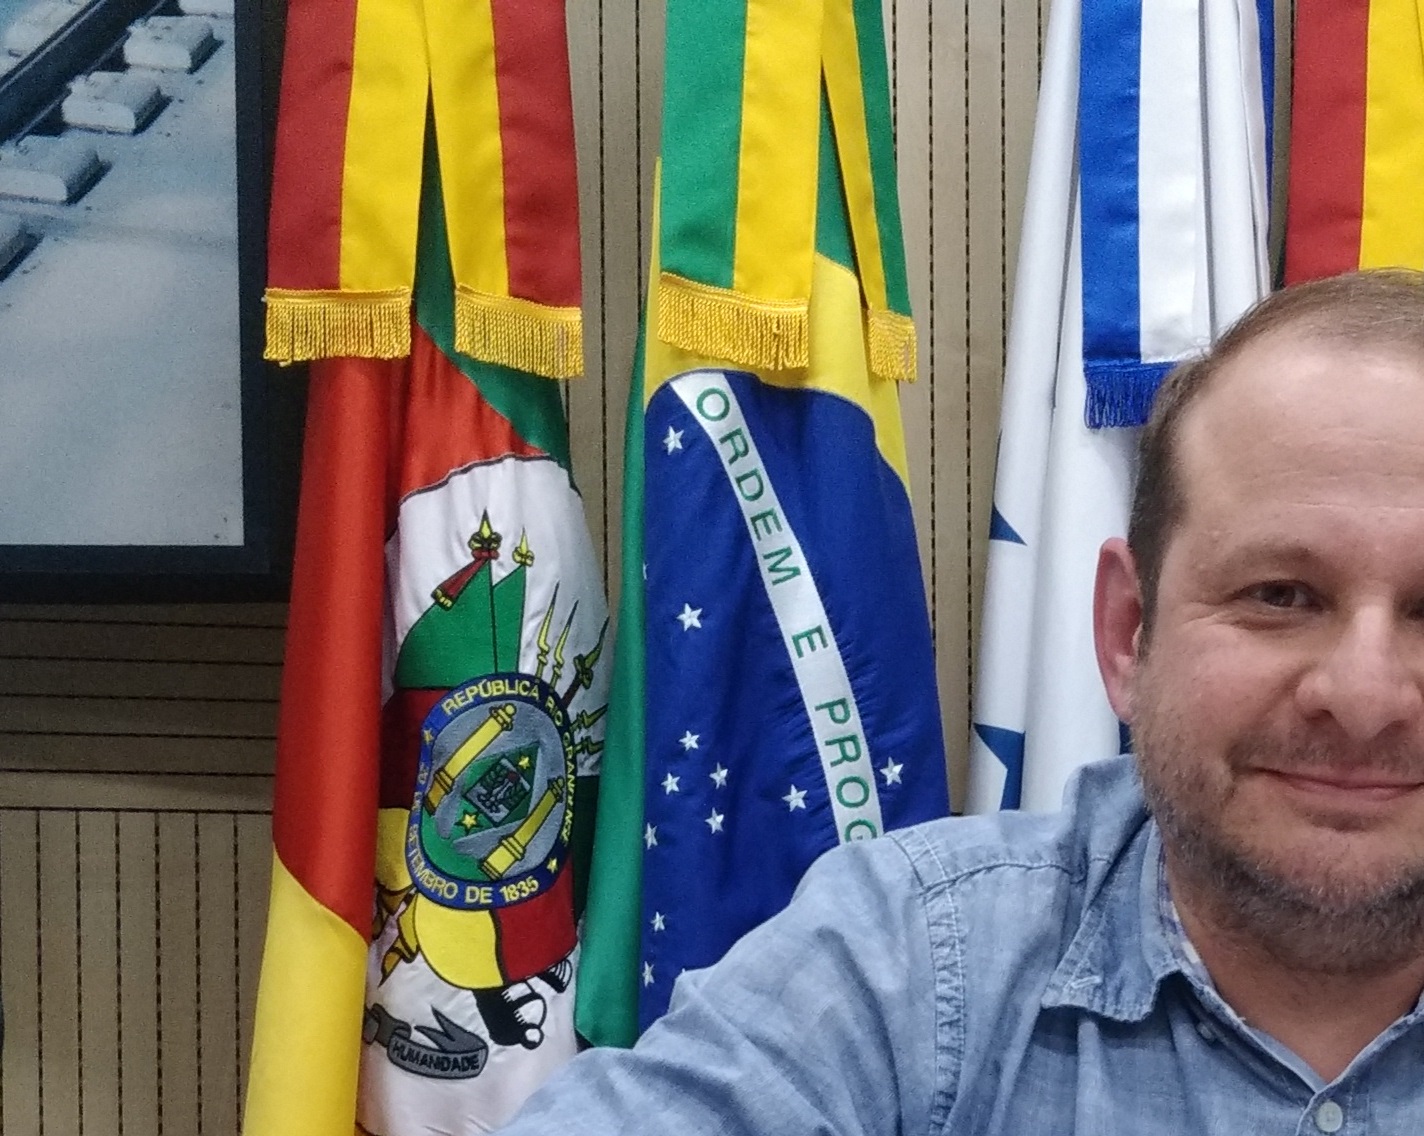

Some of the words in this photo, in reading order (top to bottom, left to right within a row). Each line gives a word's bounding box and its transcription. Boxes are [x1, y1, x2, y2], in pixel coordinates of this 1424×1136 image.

[696, 386, 802, 586] ORDEM
[791, 624, 829, 659] E
[441, 678, 540, 716] REPÚBLICA
[464, 886, 493, 904] DE
[499, 875, 539, 903] 1835
